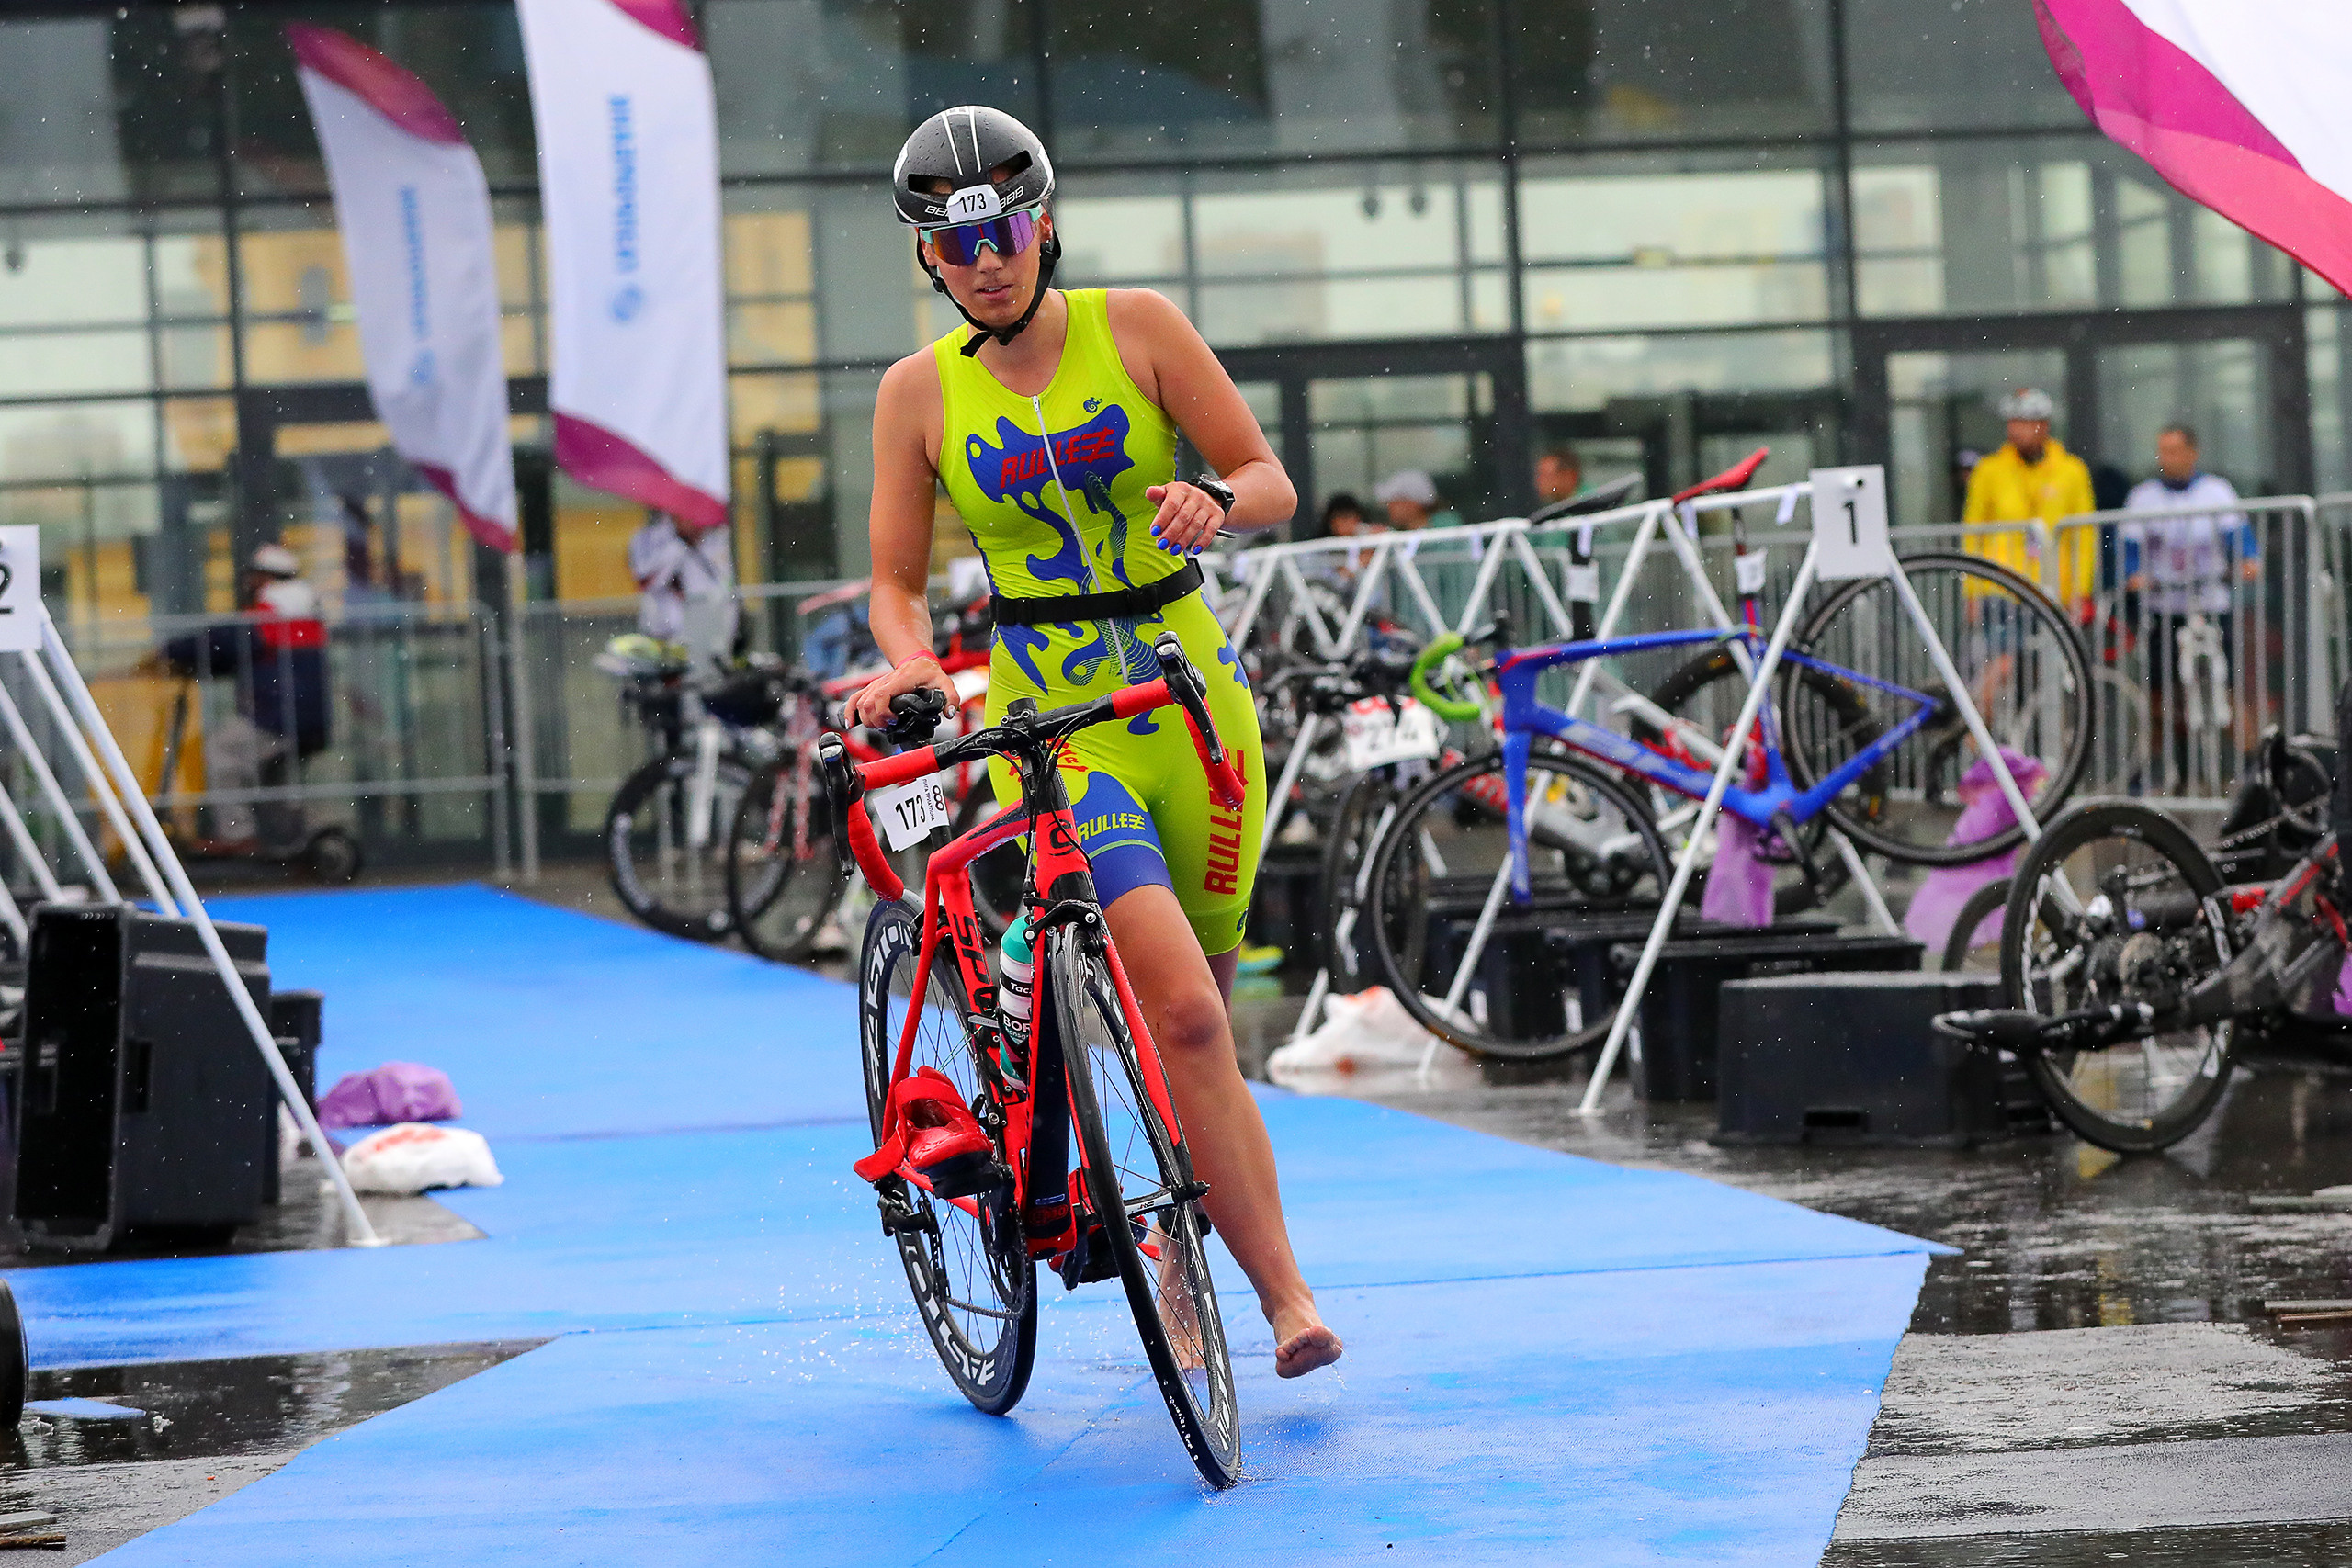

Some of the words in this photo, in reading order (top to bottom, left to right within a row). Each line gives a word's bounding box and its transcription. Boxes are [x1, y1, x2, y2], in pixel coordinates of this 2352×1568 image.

[924, 205, 948, 217] BB
[959, 192, 987, 214] 173
[1844, 501, 1858, 544] 1
[895, 794, 926, 830] 173
[1010, 982, 1032, 994] Tac
